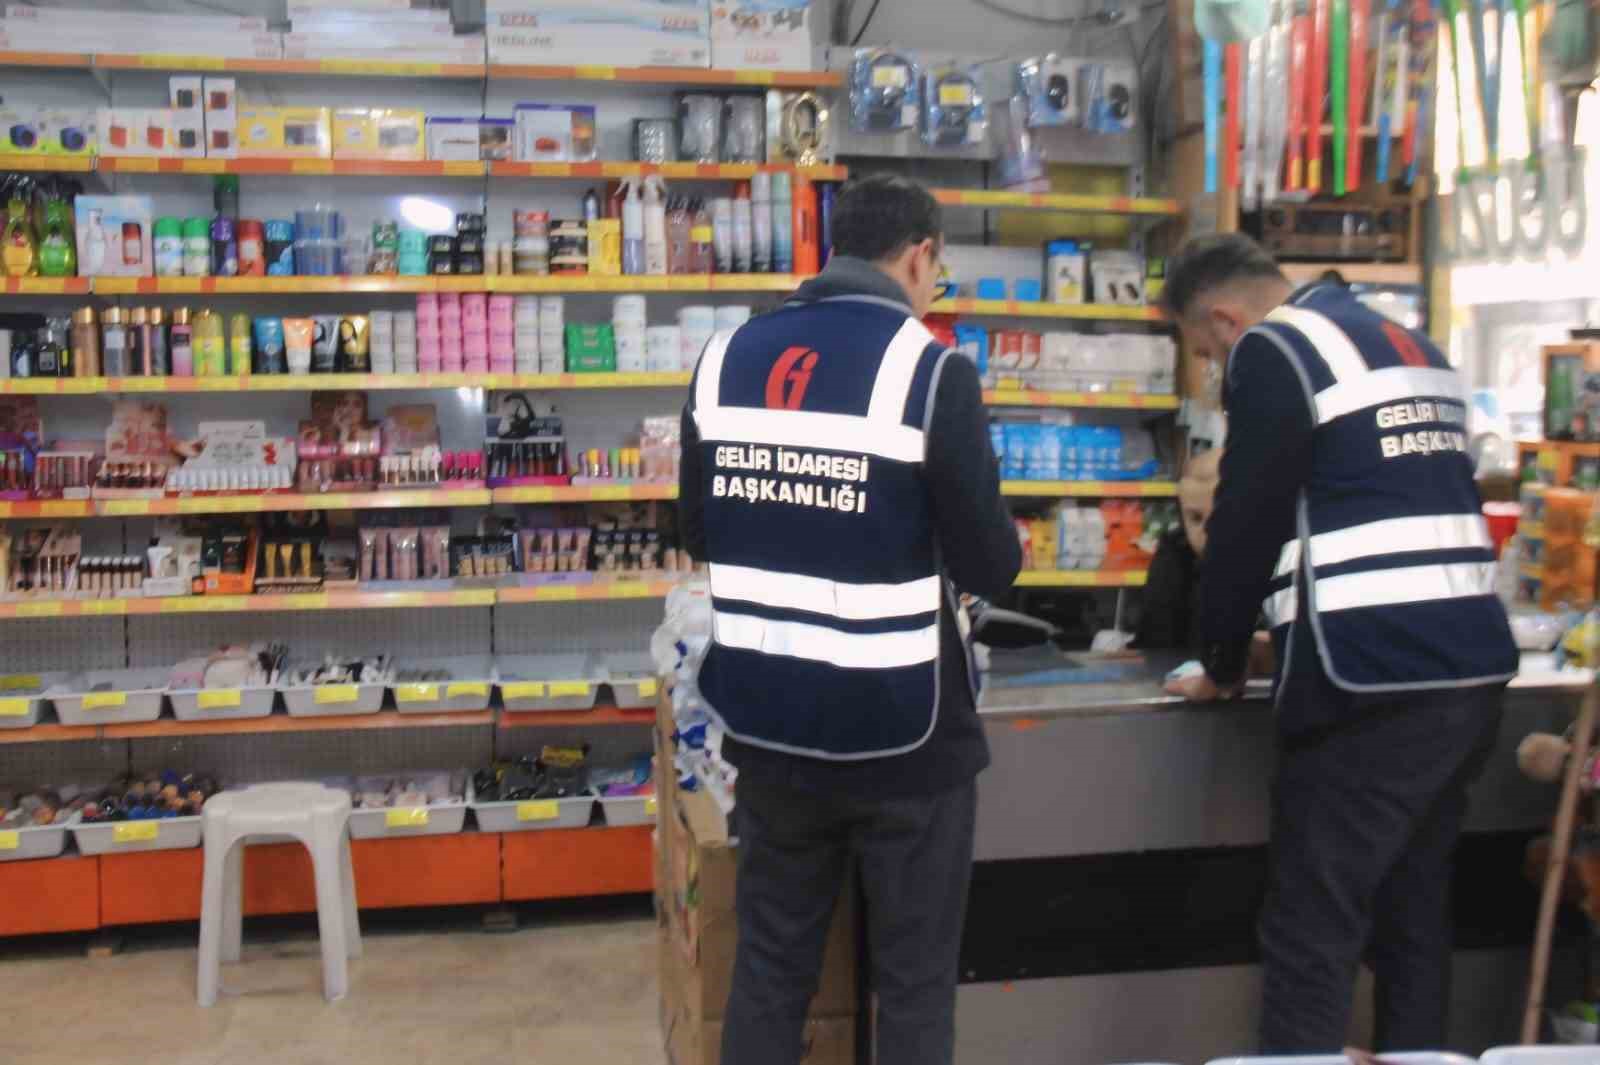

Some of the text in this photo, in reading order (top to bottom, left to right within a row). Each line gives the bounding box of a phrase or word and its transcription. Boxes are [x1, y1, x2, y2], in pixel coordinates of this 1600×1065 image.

[715, 445, 869, 482] GELİR İDARESİ
[712, 475, 866, 513] BAŞKANLIĞI
